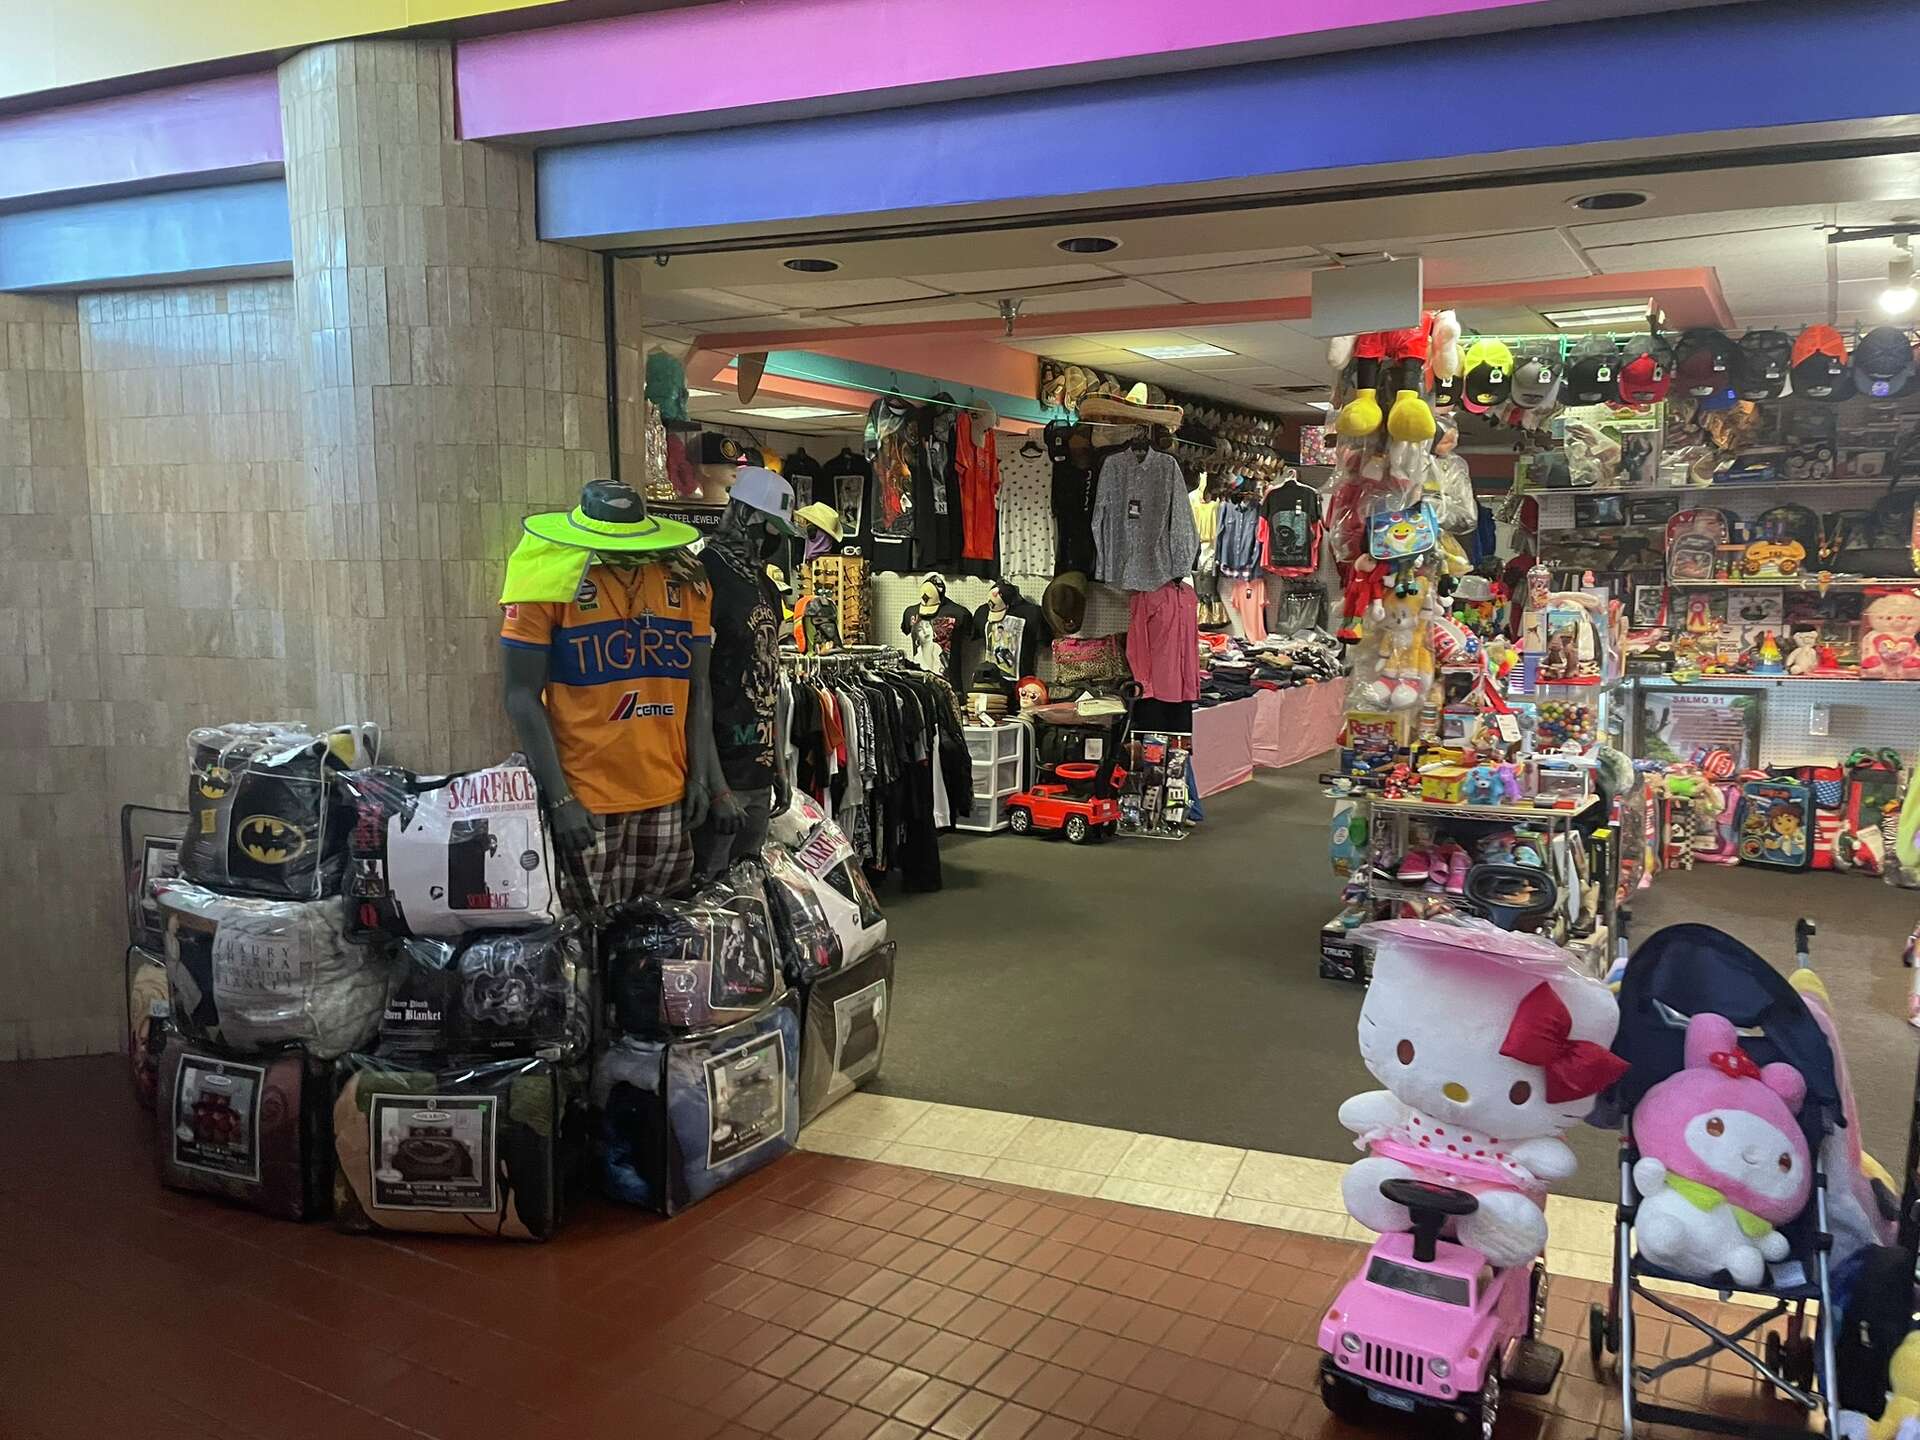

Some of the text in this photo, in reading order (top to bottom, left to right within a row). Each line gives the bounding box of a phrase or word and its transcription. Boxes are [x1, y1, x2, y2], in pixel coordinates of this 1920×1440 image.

[669, 513, 691, 524] STEEL
[692, 514, 721, 525] JEWELR
[569, 629, 693, 675] TIGRES
[1672, 695, 1725, 705] SALMO 91
[449, 770, 536, 811] SCARFACE
[1322, 946, 1353, 959] TRUCK
[404, 1009, 441, 1021] Blanket
